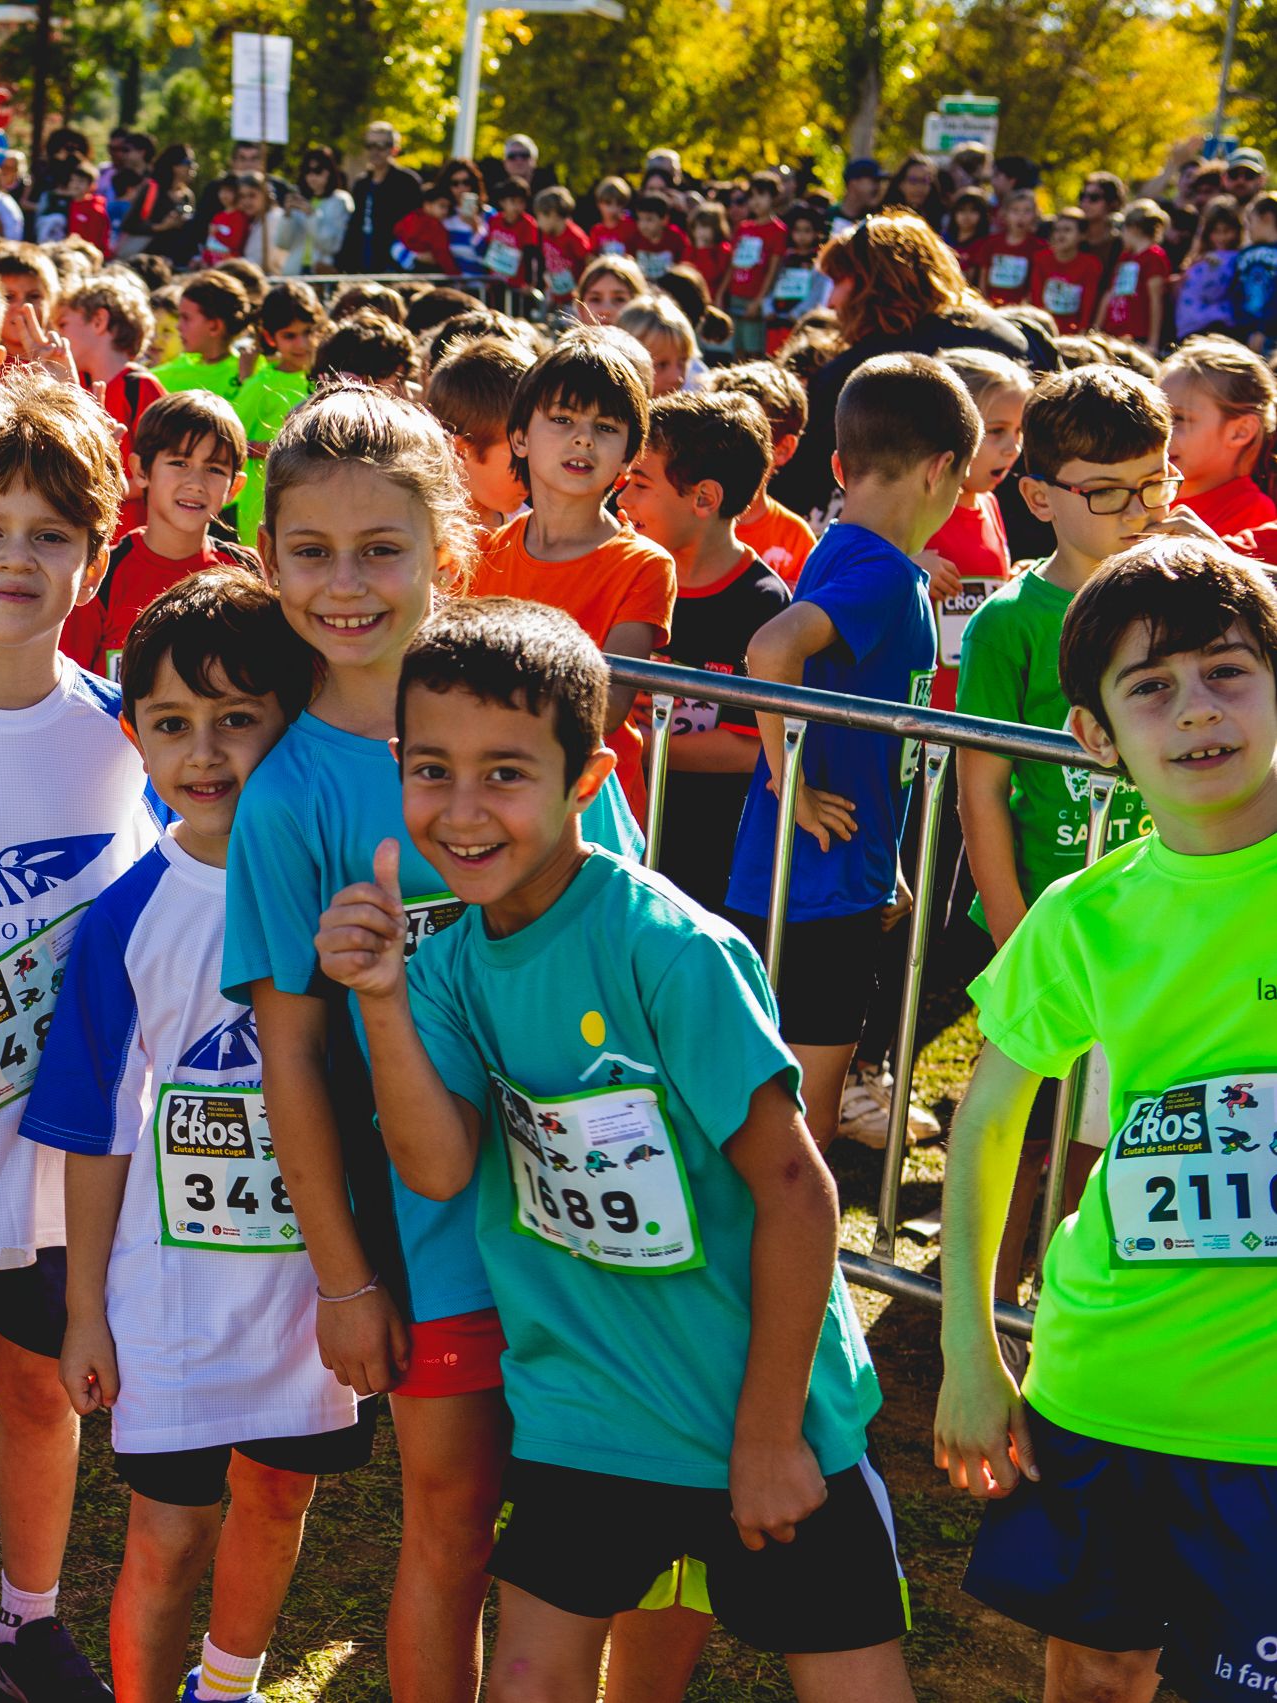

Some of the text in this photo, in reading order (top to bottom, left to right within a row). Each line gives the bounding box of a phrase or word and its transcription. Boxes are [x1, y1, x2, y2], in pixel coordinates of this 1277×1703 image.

[171, 1120, 245, 1147] CROS
[1124, 1111, 1202, 1145] CROS
[173, 1146, 195, 1154] Ciutat
[206, 1147, 223, 1155] Sant
[224, 1148, 246, 1157] Cugat
[1123, 1147, 1145, 1156] Ciutat
[1157, 1144, 1176, 1152] Sant
[1178, 1142, 1202, 1152] Cugat
[524, 1161, 639, 1234] 1689
[1146, 1173, 1277, 1223] 211
[1215, 1654, 1277, 1699] la far
